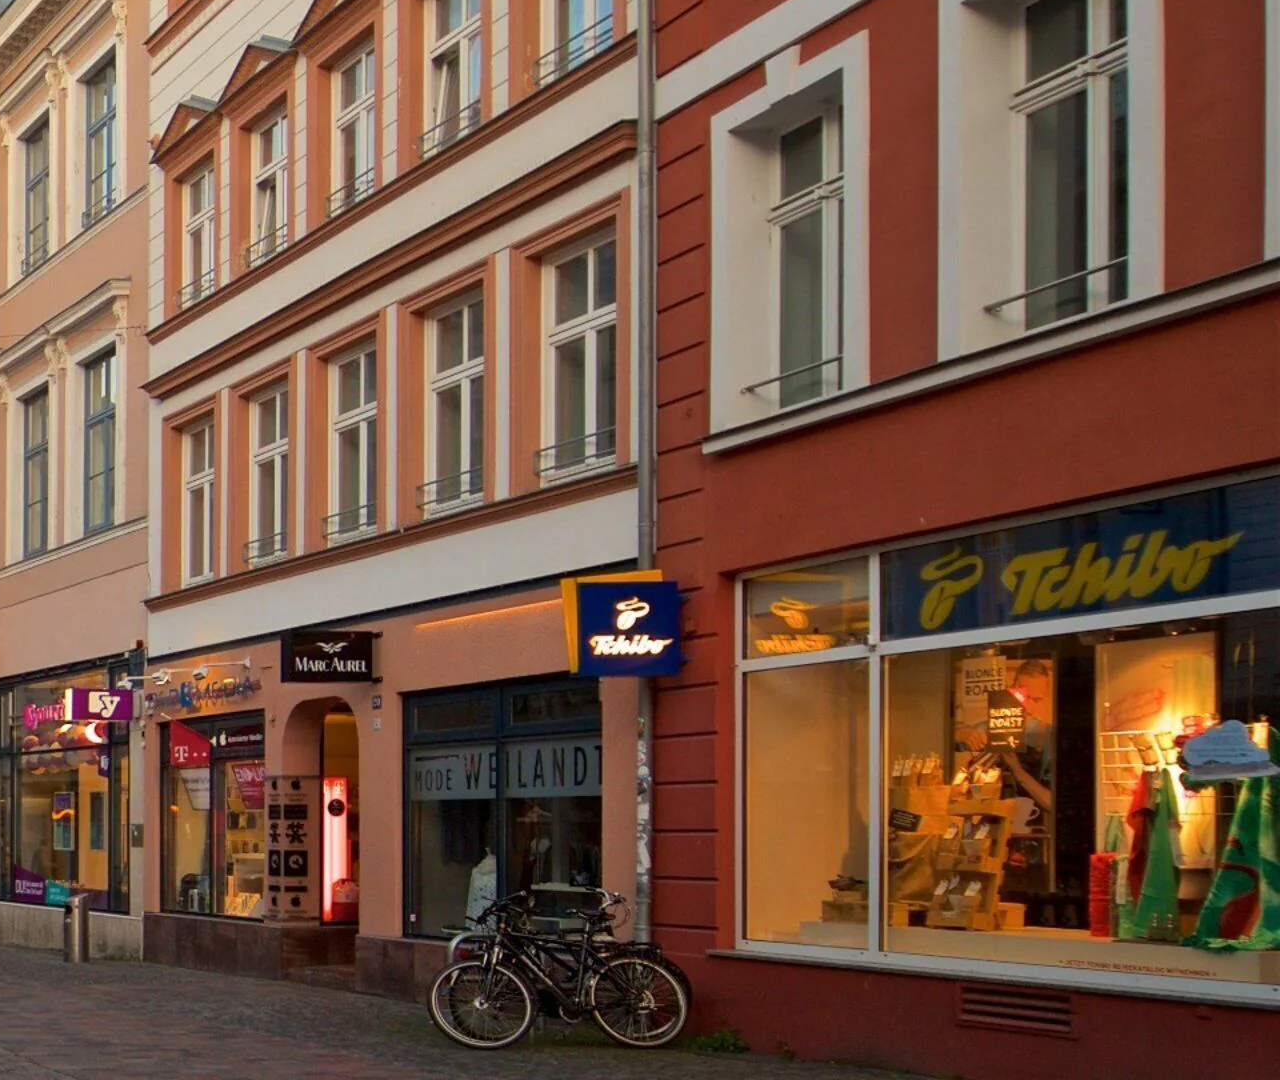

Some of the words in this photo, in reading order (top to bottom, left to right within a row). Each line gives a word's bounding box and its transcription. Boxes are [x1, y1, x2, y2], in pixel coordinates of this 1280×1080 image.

[1000, 530, 1245, 616] Tchibo
[588, 634, 674, 655] Tchibo
[295, 656, 330, 672] MARC
[331, 657, 368, 672] AUREL
[415, 769, 452, 791] MODE
